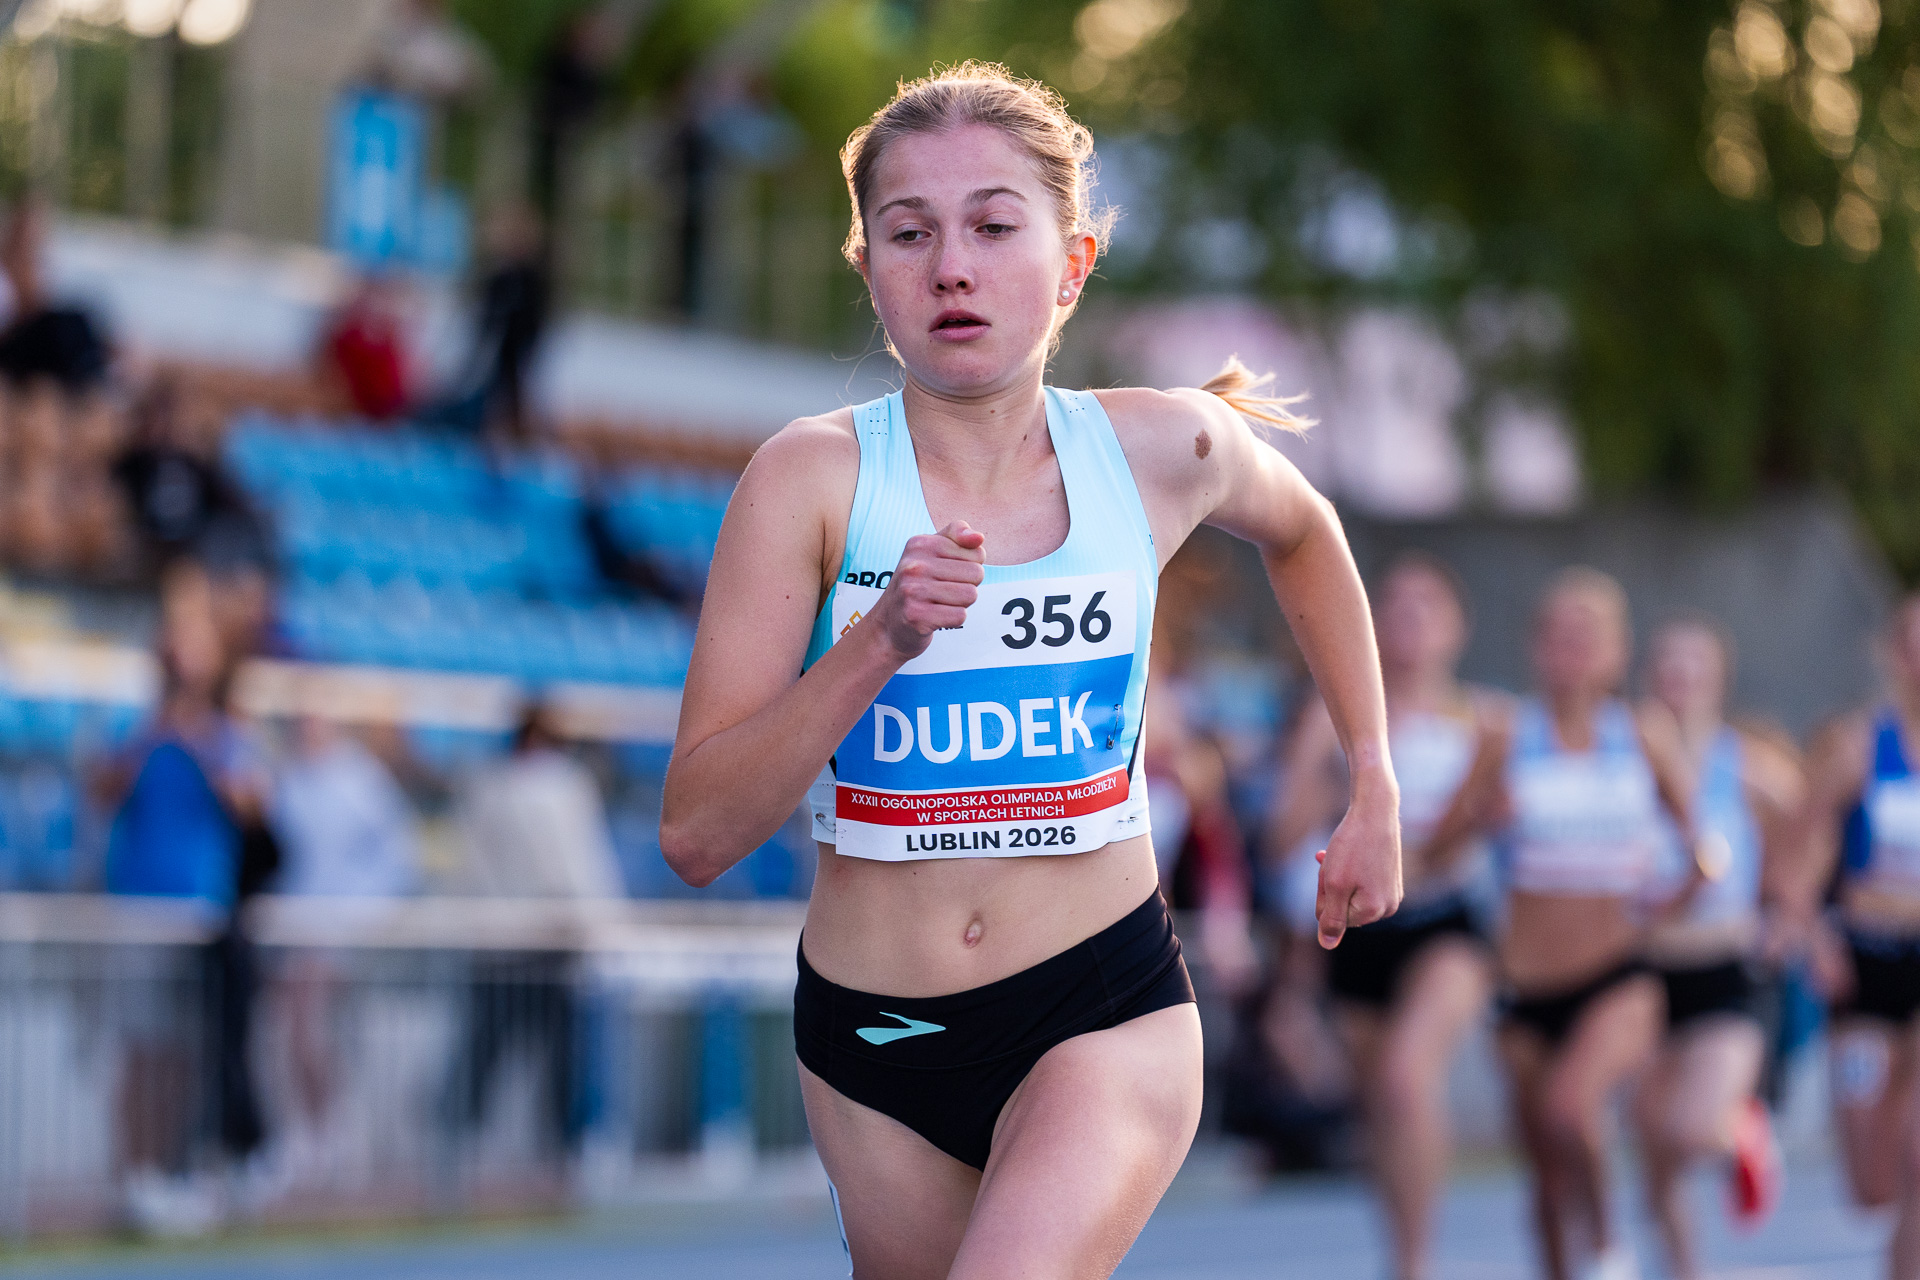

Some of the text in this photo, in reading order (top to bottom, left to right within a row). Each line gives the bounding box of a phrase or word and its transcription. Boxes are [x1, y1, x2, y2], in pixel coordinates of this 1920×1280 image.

[844, 571, 894, 590] BRO
[1001, 590, 1112, 650] 356
[873, 690, 1095, 765] DUDEK
[851, 776, 1117, 810] XXXII OGÓLNOPOLSKA OLIMPIADA MŁODZIEŻY
[917, 804, 1065, 823] W SPORTACH LETNICH
[906, 825, 1077, 852] LUBLIN 2026
